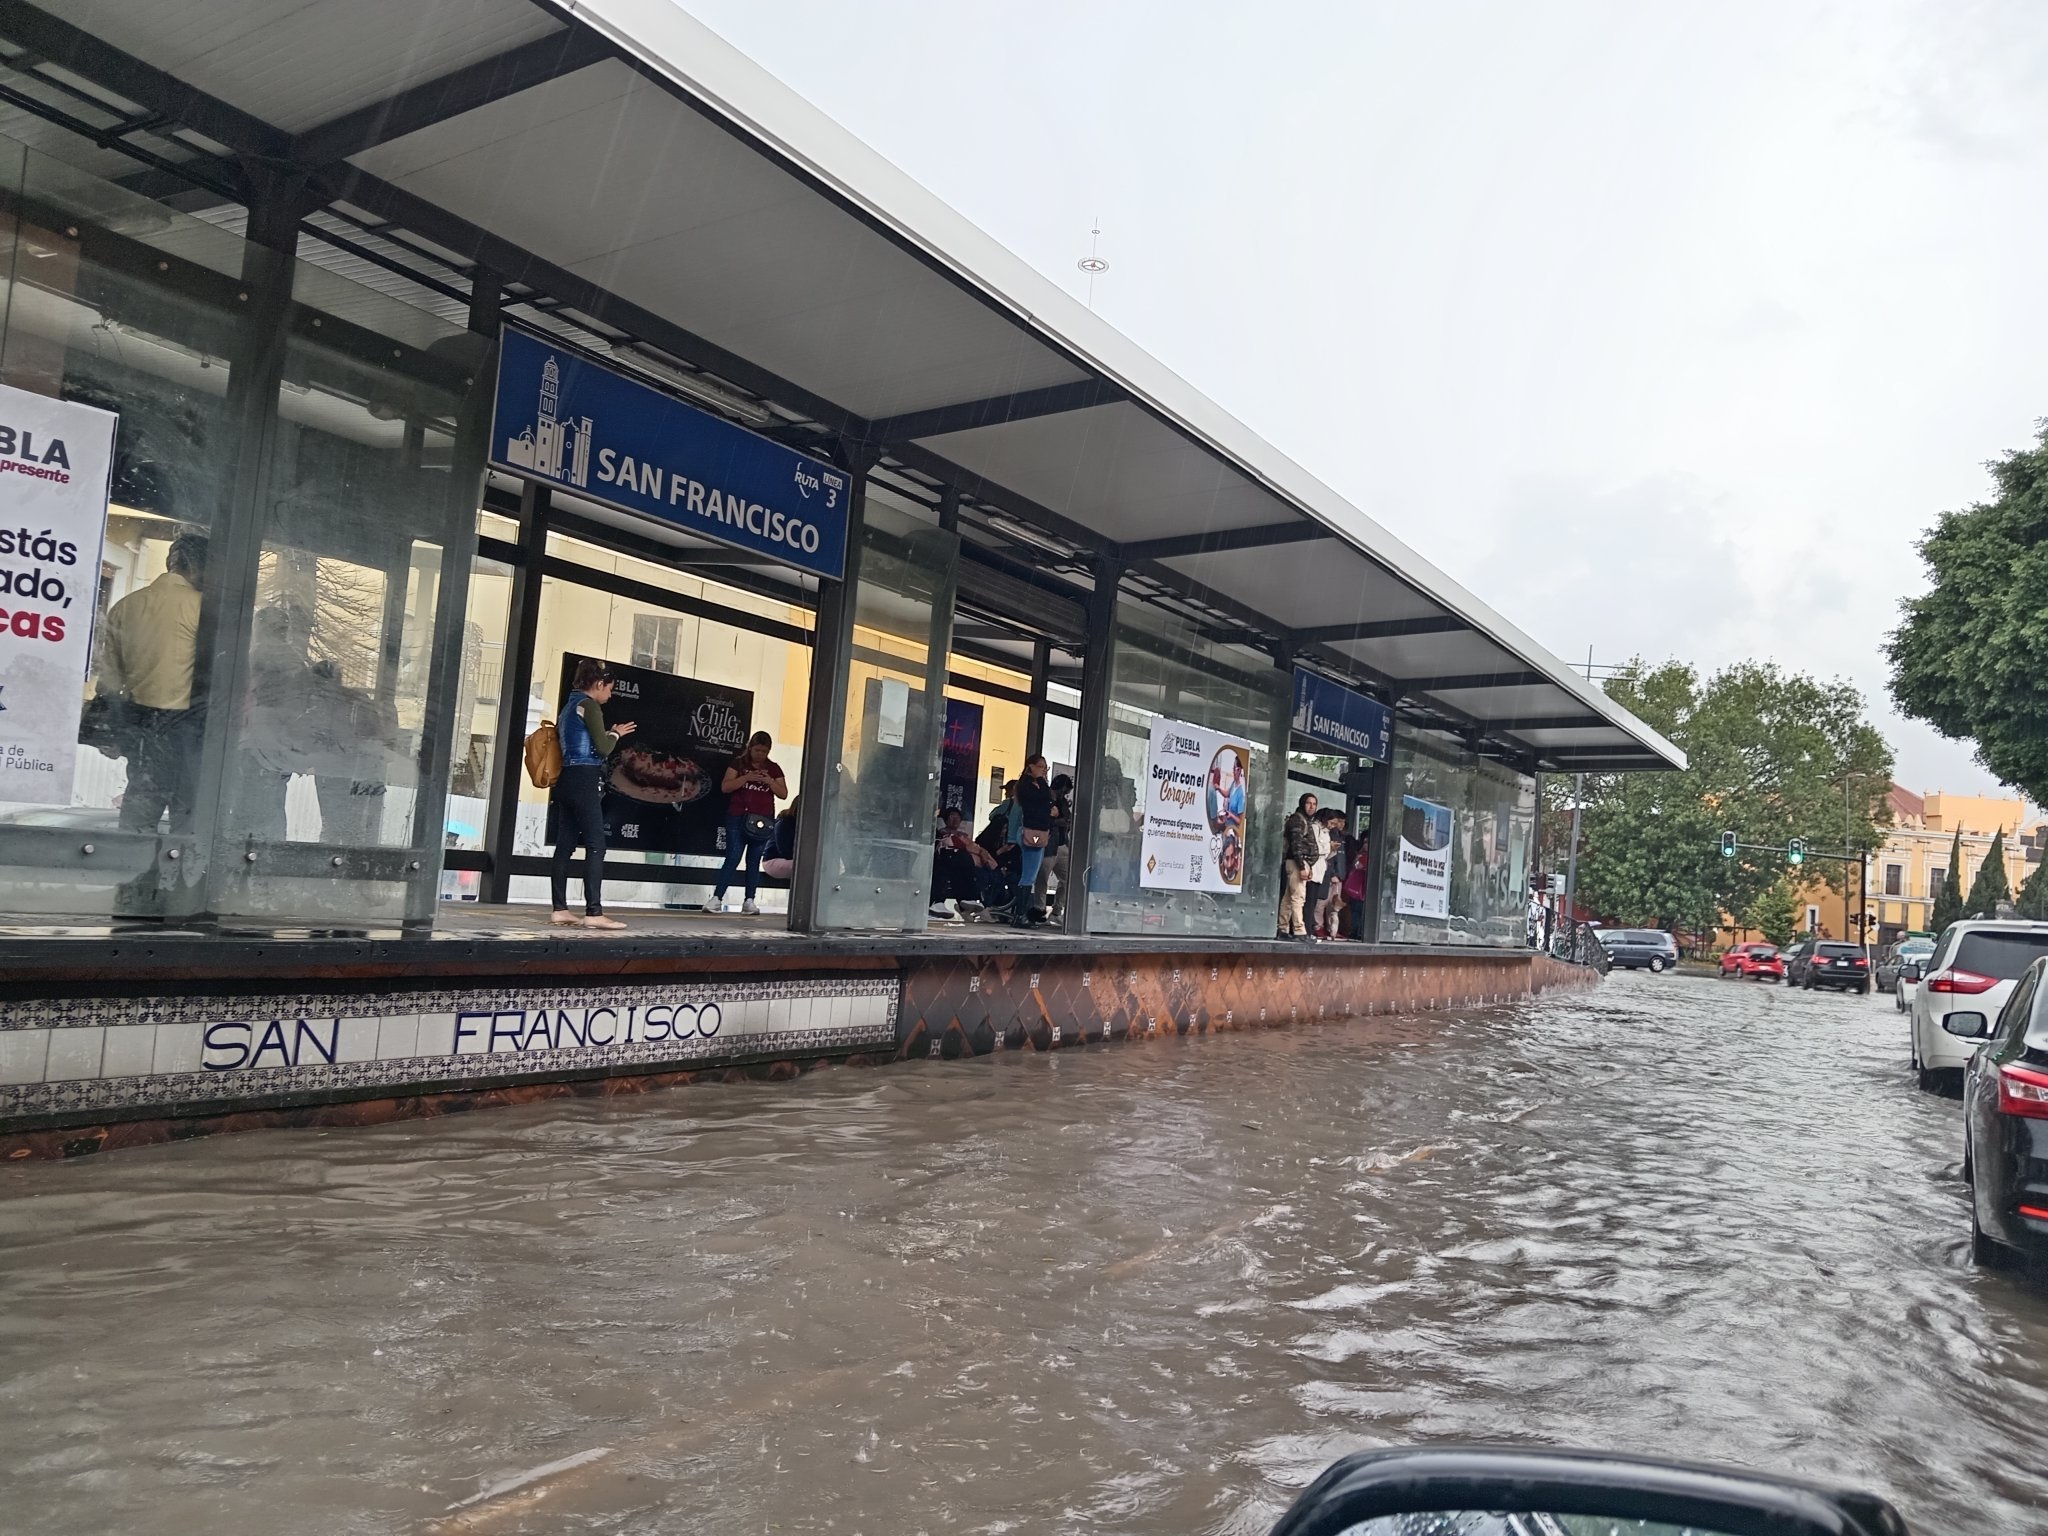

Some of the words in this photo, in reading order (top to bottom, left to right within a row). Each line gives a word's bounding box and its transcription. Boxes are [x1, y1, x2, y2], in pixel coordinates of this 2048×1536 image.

[0, 458, 70, 484] presente
[794, 471, 819, 491] RUTA
[597, 448, 663, 499] SAN
[669, 473, 819, 553] FRANCISCO
[826, 488, 837, 508] 3
[697, 703, 737, 728] Chile
[687, 716, 744, 745] Nogada
[1313, 714, 1330, 735] SAN
[1330, 720, 1369, 749] FRANCISCO
[8, 745, 24, 756] de
[1176, 736, 1200, 752] PUEBLA
[1380, 742, 1386, 758] 3
[6, 757, 54, 772] Pública
[1152, 764, 1179, 783] Servir
[1180, 772, 1195, 786] con
[1197, 774, 1205, 788] el
[1160, 779, 1196, 809] Corazón
[202, 1017, 340, 1071] SAN
[452, 1003, 722, 1055] FRANCISCO
